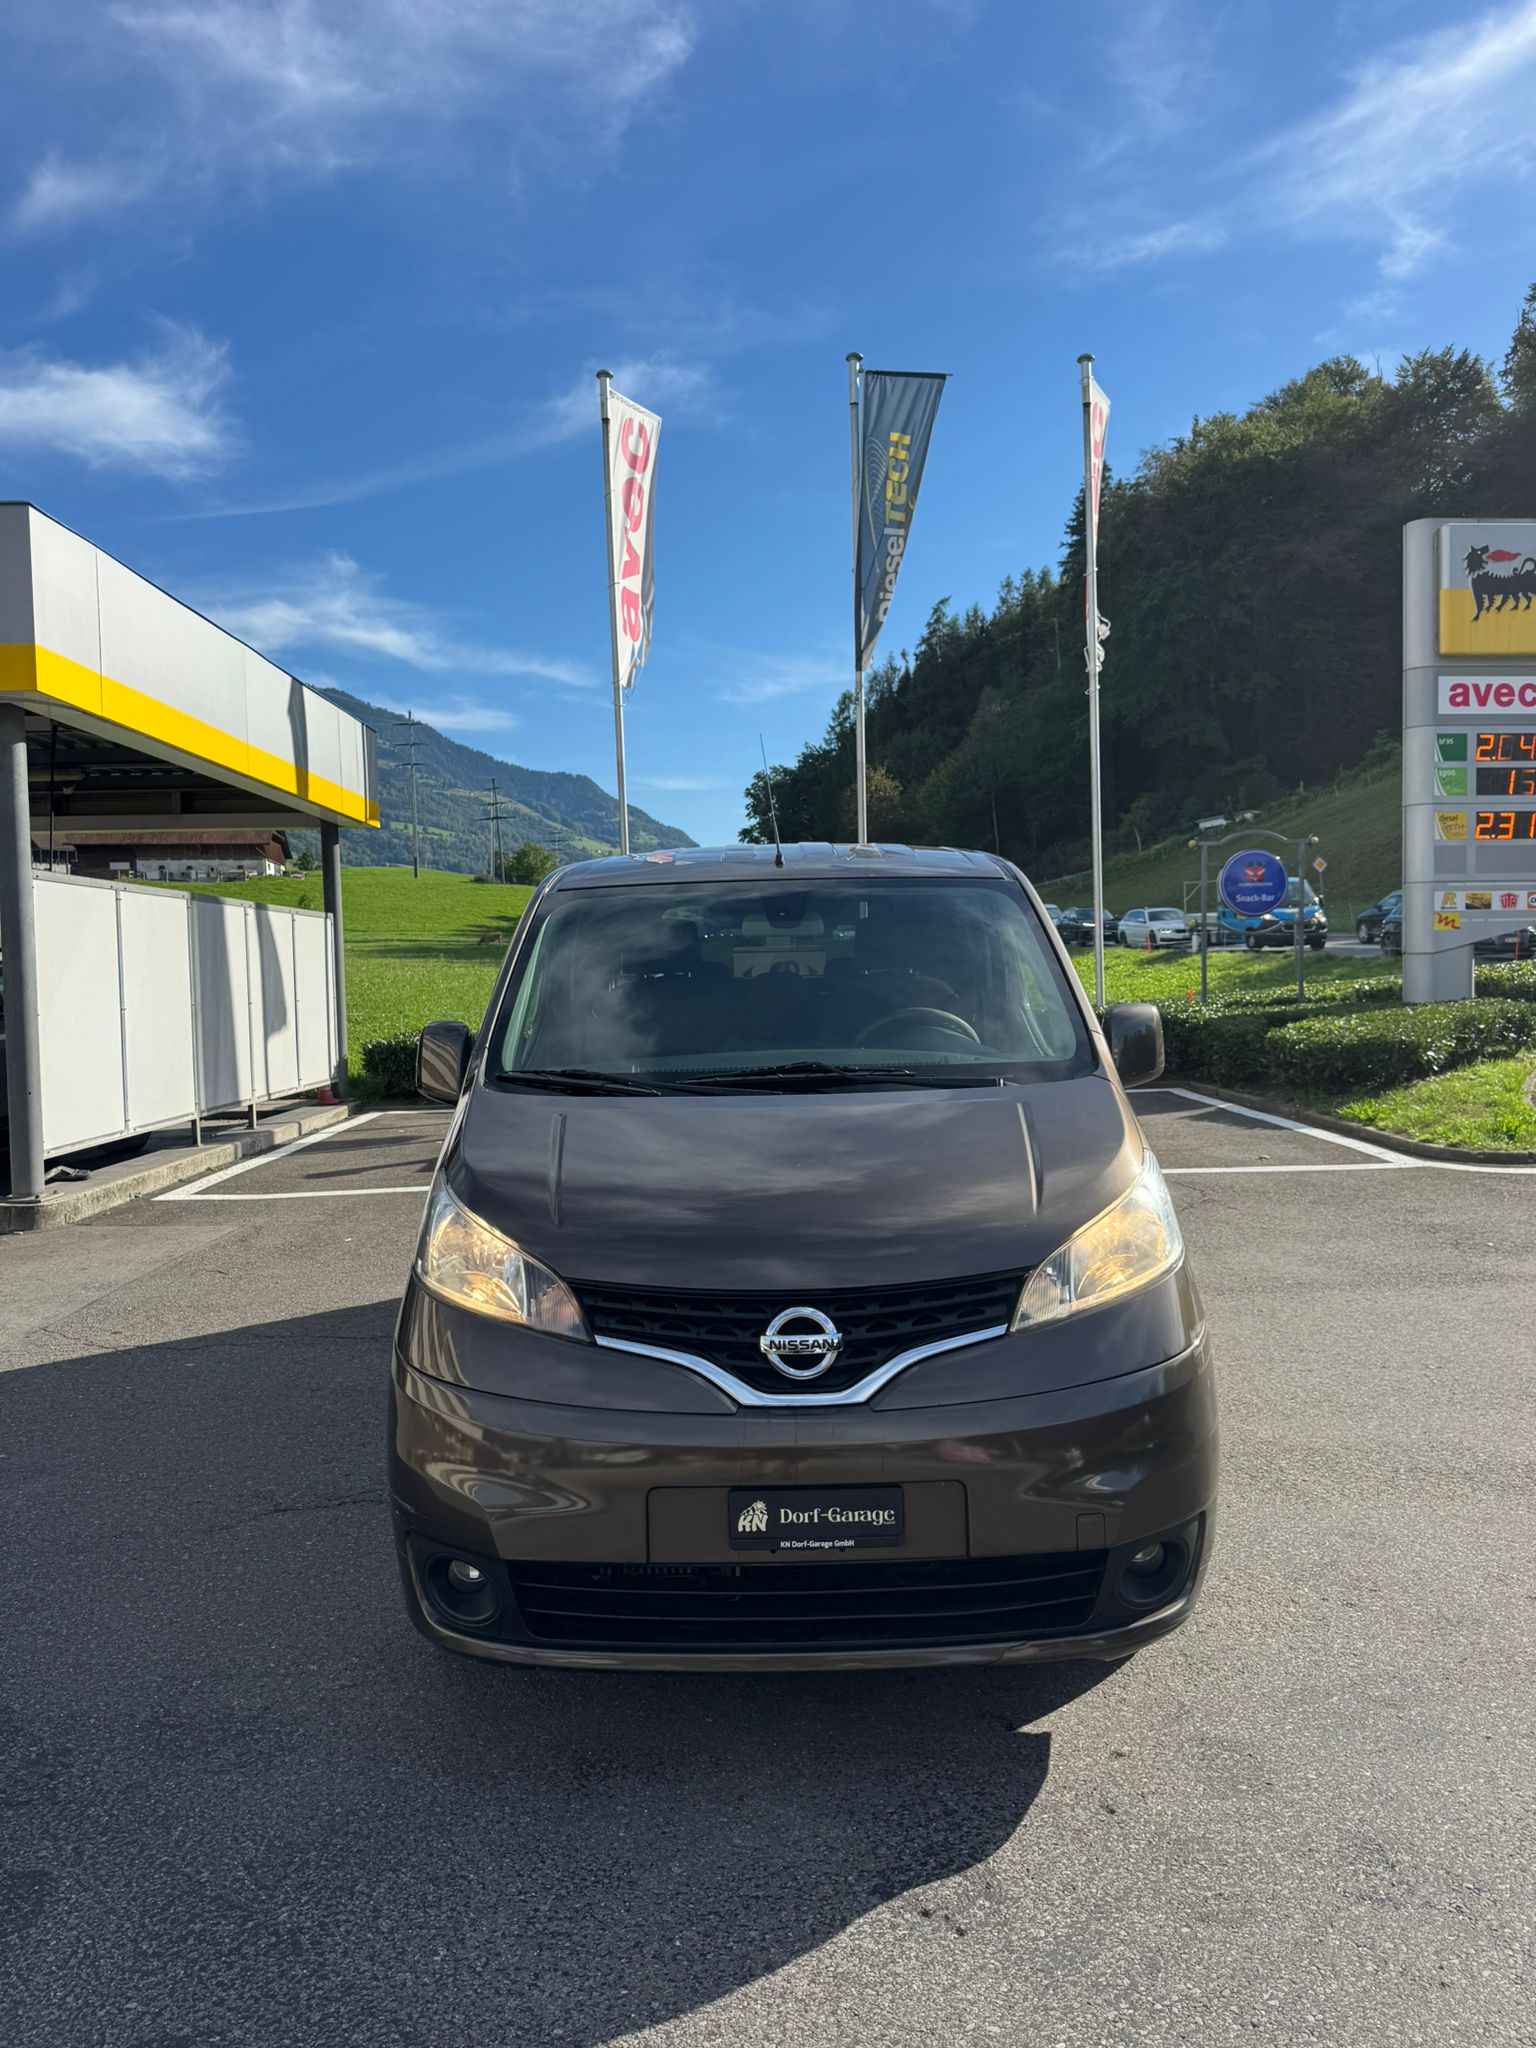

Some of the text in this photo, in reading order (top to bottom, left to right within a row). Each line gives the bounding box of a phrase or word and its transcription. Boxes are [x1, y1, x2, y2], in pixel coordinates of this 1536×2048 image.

[621, 417, 651, 643] avec
[1448, 682, 1536, 708] avec
[1438, 814, 1458, 822] diesel
[1235, 893, 1275, 903] Snack-Bar
[769, 1338, 835, 1351] NISSAN
[738, 1513, 769, 1532] KN
[779, 1507, 895, 1526] Dorf-Garage
[780, 1539, 855, 1549] KN Dorf-Garage GmbH
